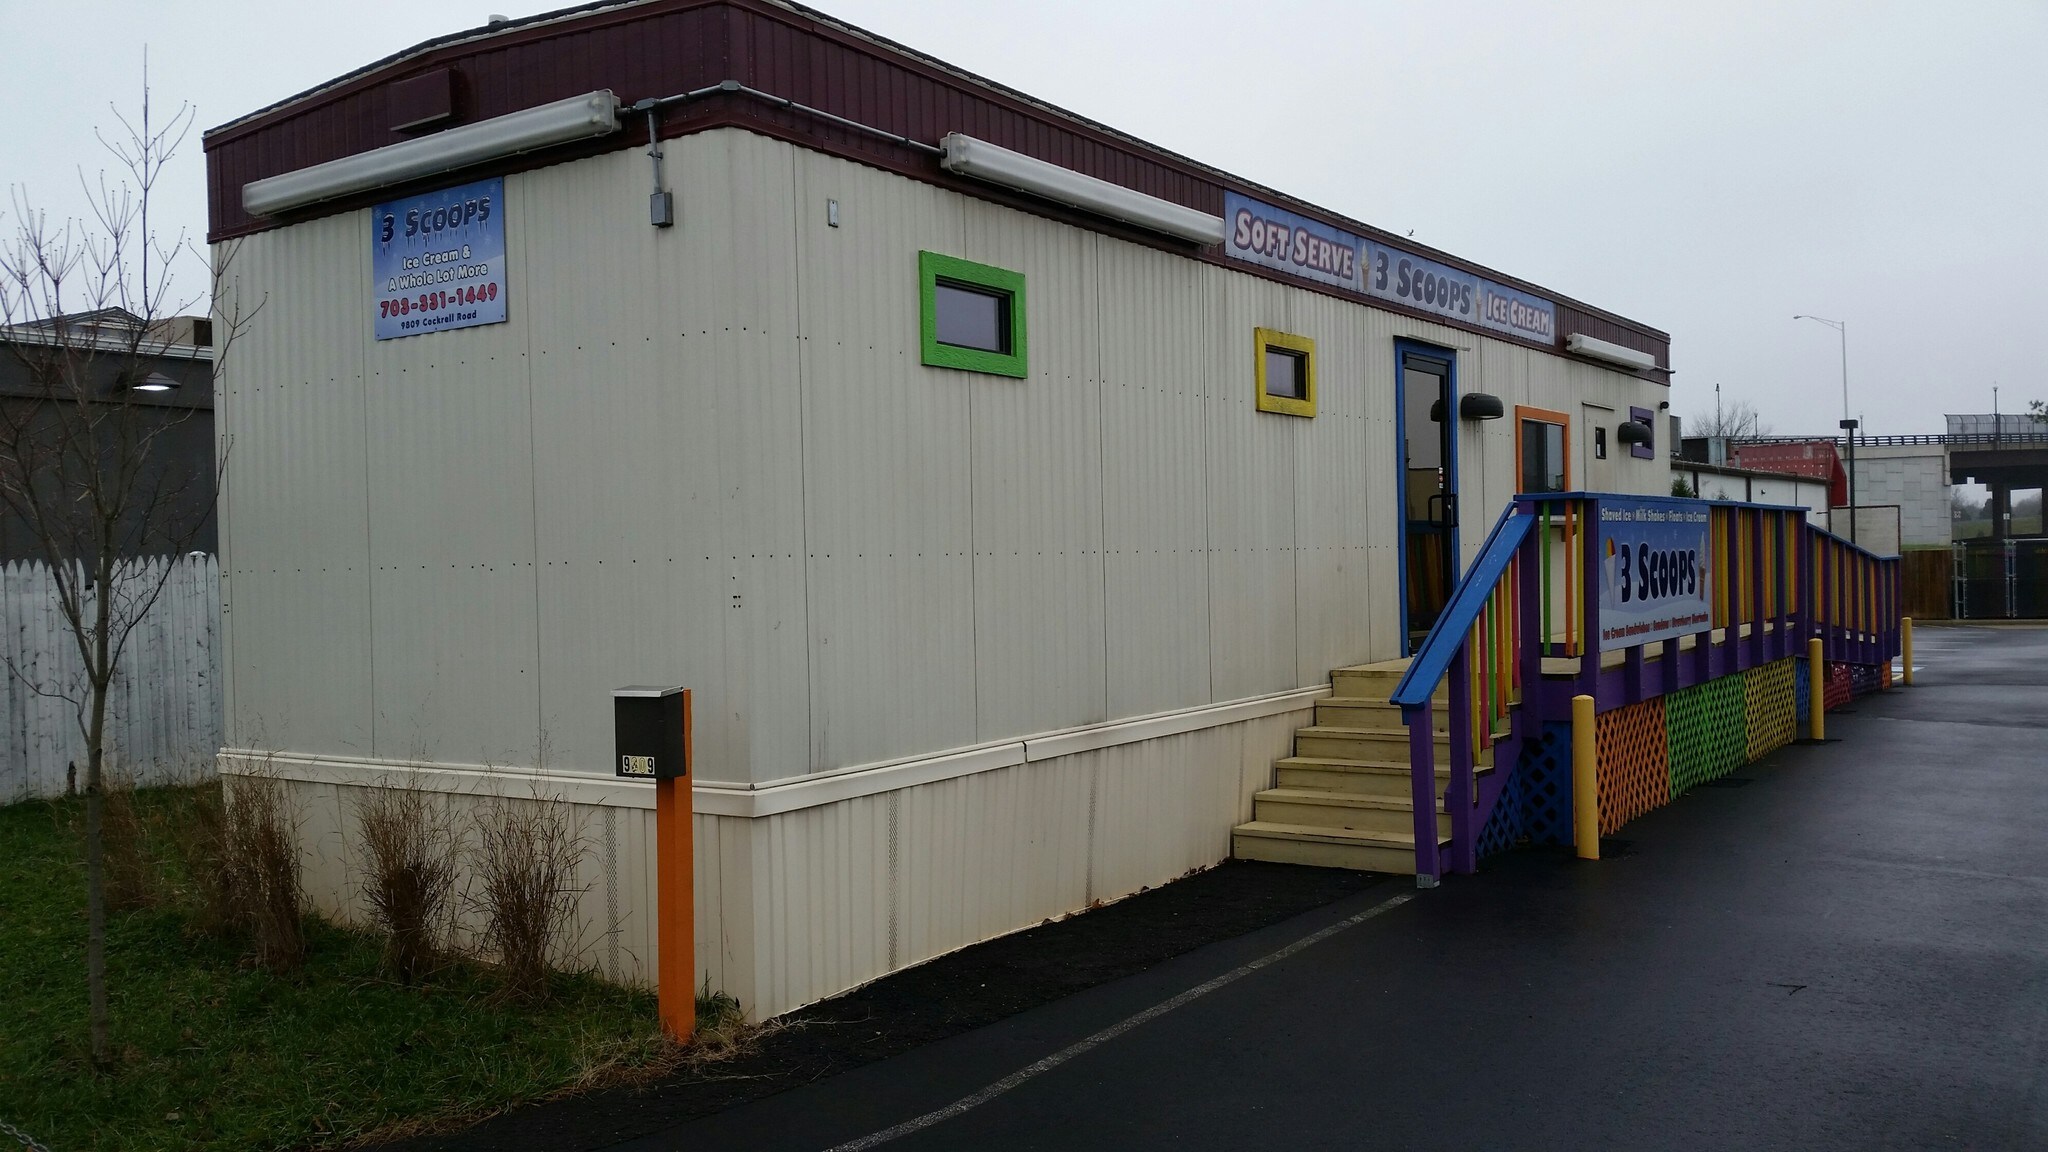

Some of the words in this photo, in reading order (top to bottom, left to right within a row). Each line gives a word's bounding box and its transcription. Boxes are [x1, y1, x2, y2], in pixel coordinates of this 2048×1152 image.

[381, 212, 395, 245] 3
[405, 195, 491, 240] SCOOPS
[402, 256, 419, 270] Ice
[422, 249, 459, 266] Cream
[461, 244, 471, 259] &
[1234, 207, 1290, 261] SOFT
[1292, 226, 1354, 281] SERVE
[1375, 251, 1390, 291] 3
[1396, 257, 1473, 316] SCOOPS
[1485, 289, 1507, 324] ICE
[1508, 299, 1551, 337] CREAM
[388, 277, 397, 292] A
[399, 271, 434, 290] Whole
[437, 268, 455, 284] Lot
[457, 263, 488, 280] More
[380, 282, 498, 319] 703-331-1449
[401, 319, 419, 330] 9809
[422, 313, 454, 327] Cockrell
[457, 309, 477, 321] Road
[1601, 507, 1622, 521] Shaved
[1622, 508, 1632, 521] Ice
[1621, 543, 1631, 603] 3
[1638, 542, 1696, 601] SCOOPS
